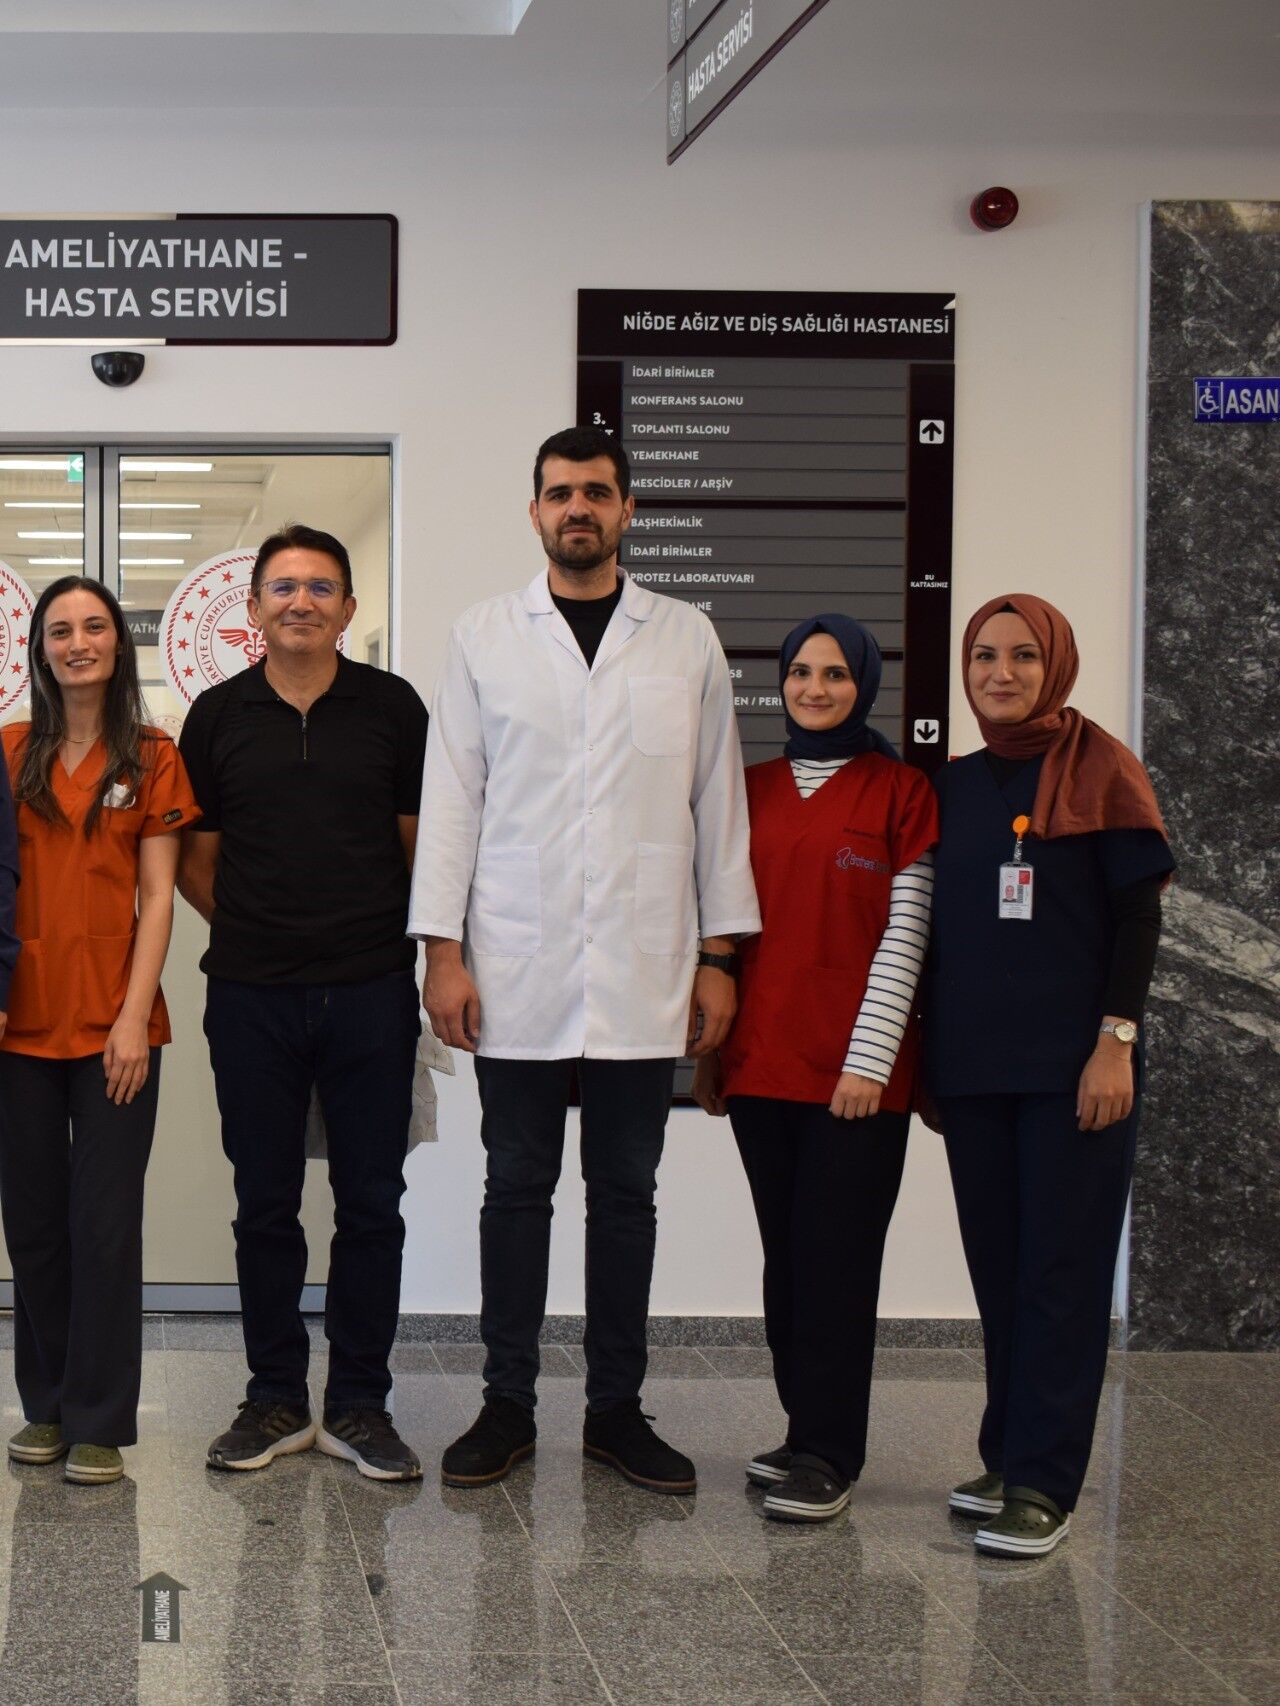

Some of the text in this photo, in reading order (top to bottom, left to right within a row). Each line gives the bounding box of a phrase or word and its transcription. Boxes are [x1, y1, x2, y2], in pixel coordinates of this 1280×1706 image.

[688, 0, 753, 103] HASTA SERVİSİ
[4, 232, 283, 268] AMELİYATHANE
[25, 281, 287, 317] HASTA SERVİSİ
[623, 312, 949, 335] NİĞDE AĞIZ VE DİŞ SAĞLIĞI HASTANESİ
[632, 366, 715, 378] İDARİ BİRİMLER
[631, 396, 744, 406] KONFERANS SALONU
[1225, 388, 1279, 415] ASAN
[592, 411, 606, 425] 3.
[631, 424, 730, 434] TOPLANTI SALONU
[632, 450, 699, 460] YEMEKHANE
[630, 476, 691, 489] MESCİDLER
[700, 477, 733, 491] ARŞİV
[630, 515, 703, 530] BAŞHEKİMLİK
[630, 544, 713, 556] İDARİ BİRİMLER
[629, 573, 755, 583] PROTEZ LABORATUVARI
[758, 694, 782, 706] PERİ
[150, 1590, 170, 1641] AMELİYATHANE
